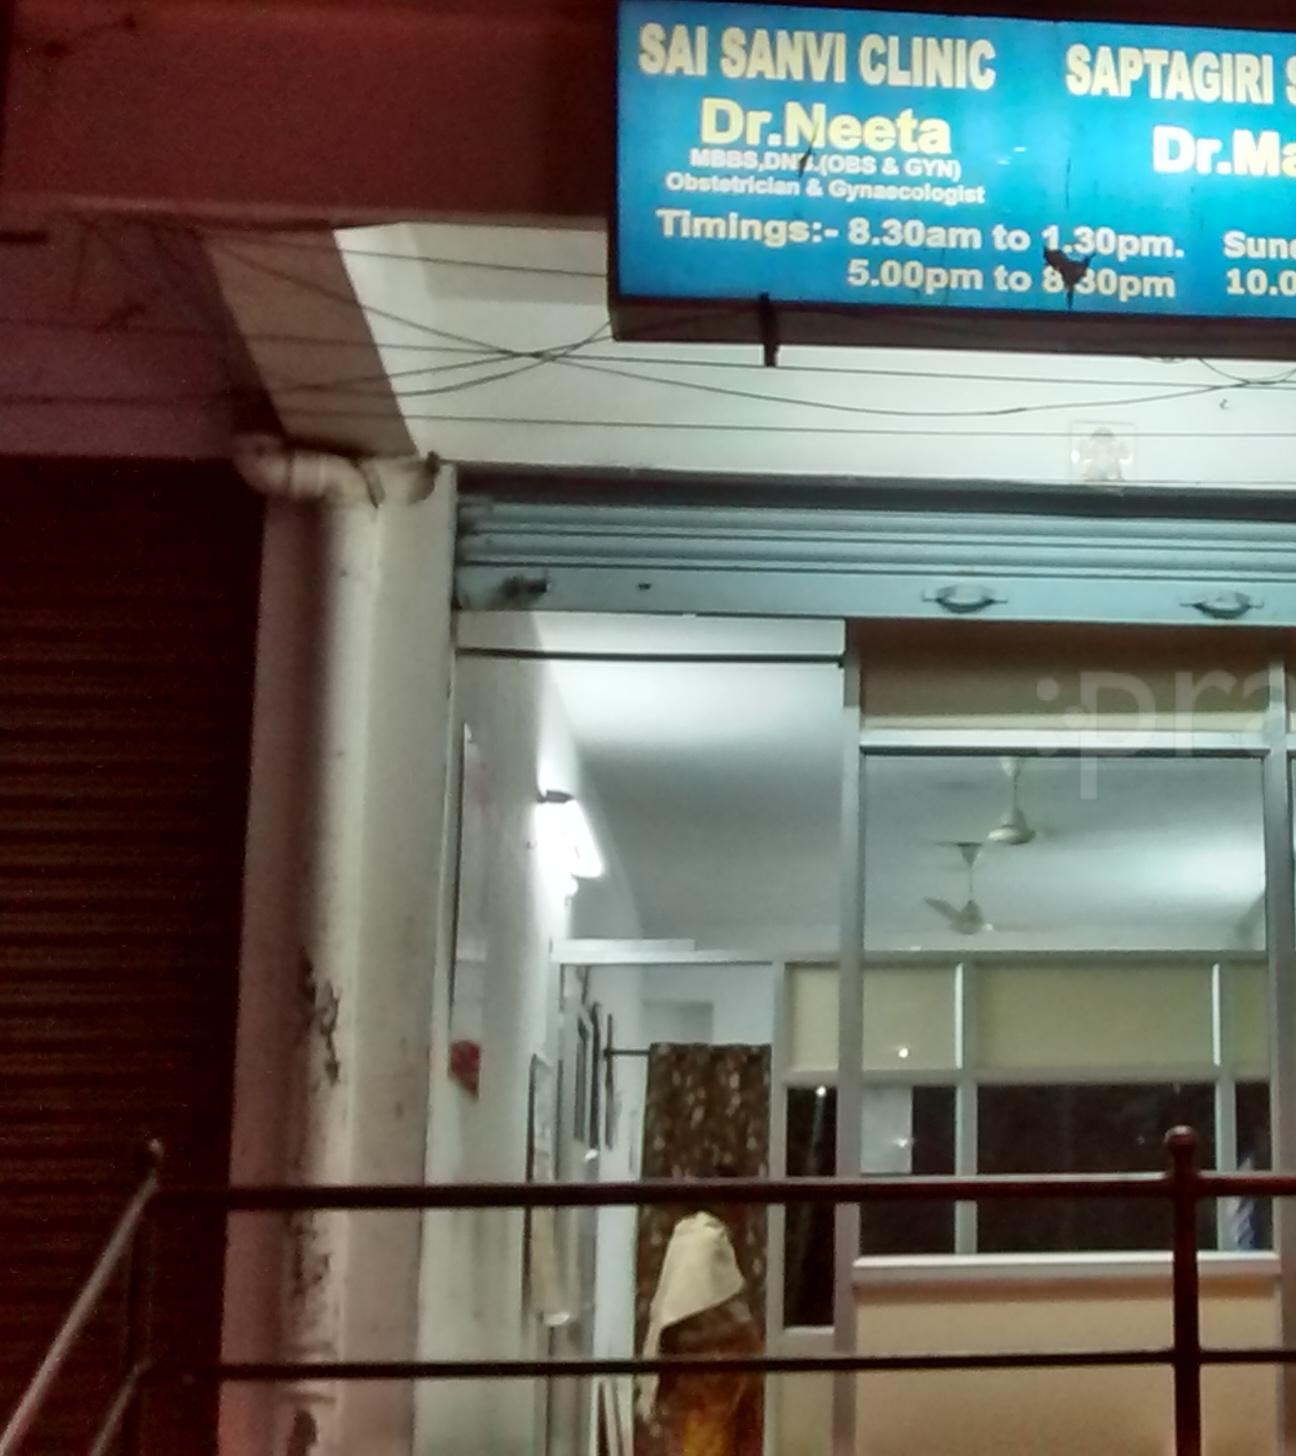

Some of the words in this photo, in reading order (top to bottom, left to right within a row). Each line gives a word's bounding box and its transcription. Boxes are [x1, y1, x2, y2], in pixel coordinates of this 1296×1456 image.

[638, 22, 708, 77] SAI
[720, 27, 847, 84] SANVI
[858, 34, 997, 91] CLINIC
[1065, 43, 1274, 105] SAPTAGIRI
[700, 97, 952, 154] Dr.Neeta
[665, 172, 800, 196] Obstetrician
[806, 177, 823, 197] &
[881, 157, 899, 177] &
[904, 157, 961, 182] GYN)
[847, 216, 982, 250] 8.30am
[992, 224, 1031, 252] to
[847, 258, 983, 295] 5.00pm
[994, 264, 1031, 292] to
[1042, 265, 1176, 302] 830pm
